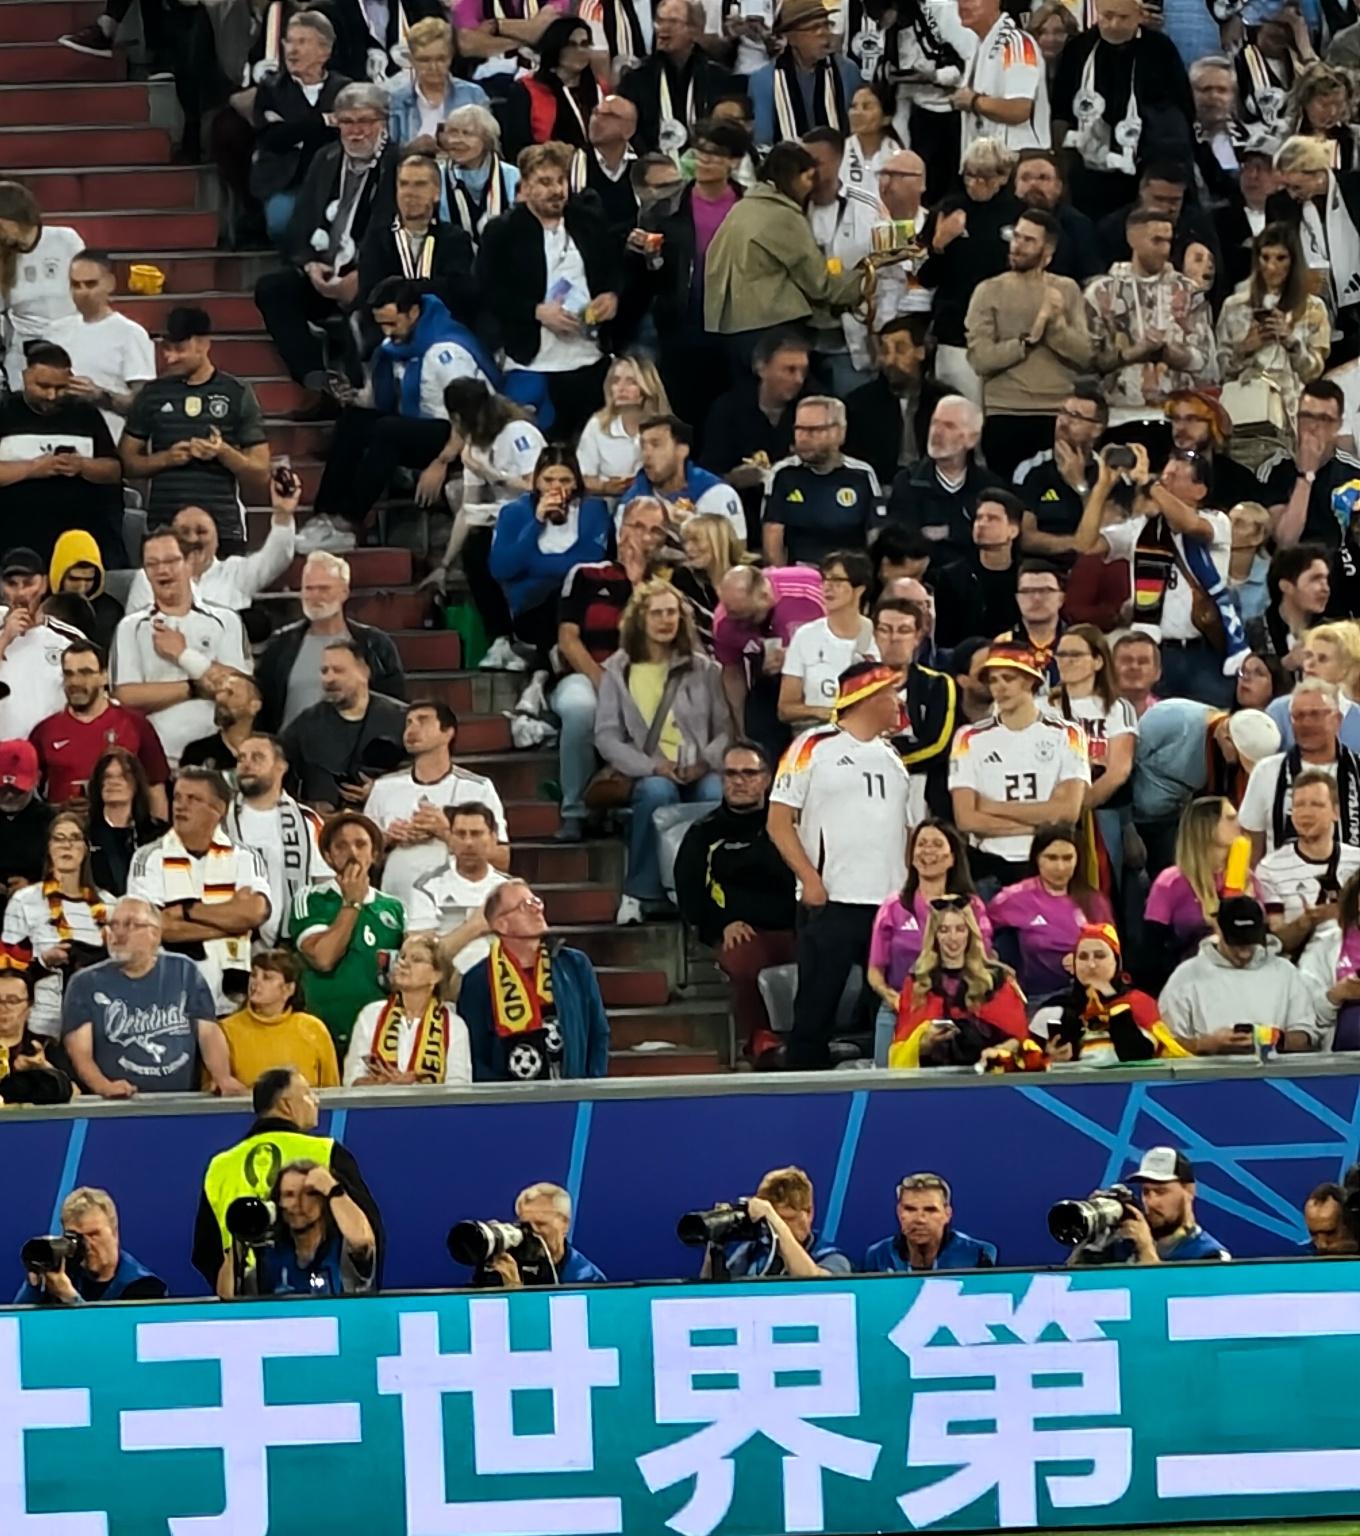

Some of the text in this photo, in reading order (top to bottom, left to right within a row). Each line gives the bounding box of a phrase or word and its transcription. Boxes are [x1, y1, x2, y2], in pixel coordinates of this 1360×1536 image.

[862, 772, 885, 799] 11
[1006, 773, 1038, 802] 23
[364, 924, 377, 947] 6
